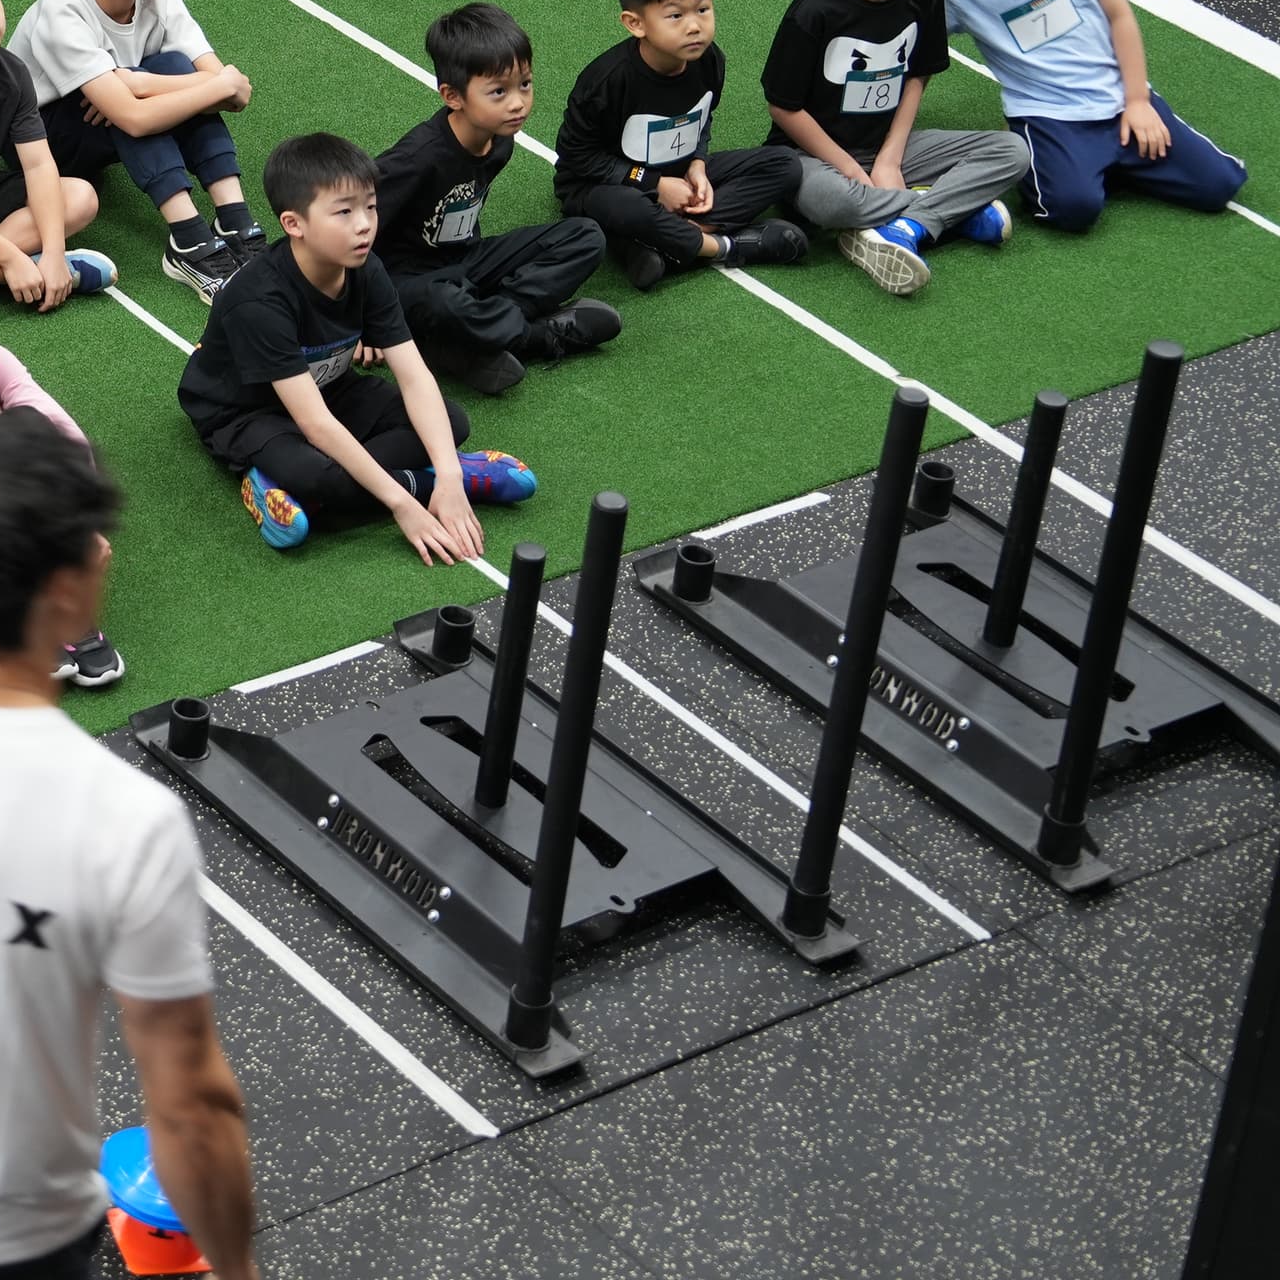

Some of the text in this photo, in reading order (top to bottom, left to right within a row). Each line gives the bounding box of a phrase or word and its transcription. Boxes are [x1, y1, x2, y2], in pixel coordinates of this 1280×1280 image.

[1031, 12, 1049, 38] 7
[859, 83, 890, 109] 18
[670, 131, 686, 156] 4
[453, 212, 474, 237] 11
[315, 357, 341, 385] 25
[869, 666, 956, 739] ONWOD
[331, 809, 438, 909] IRONWOD
[5, 899, 55, 950] X
